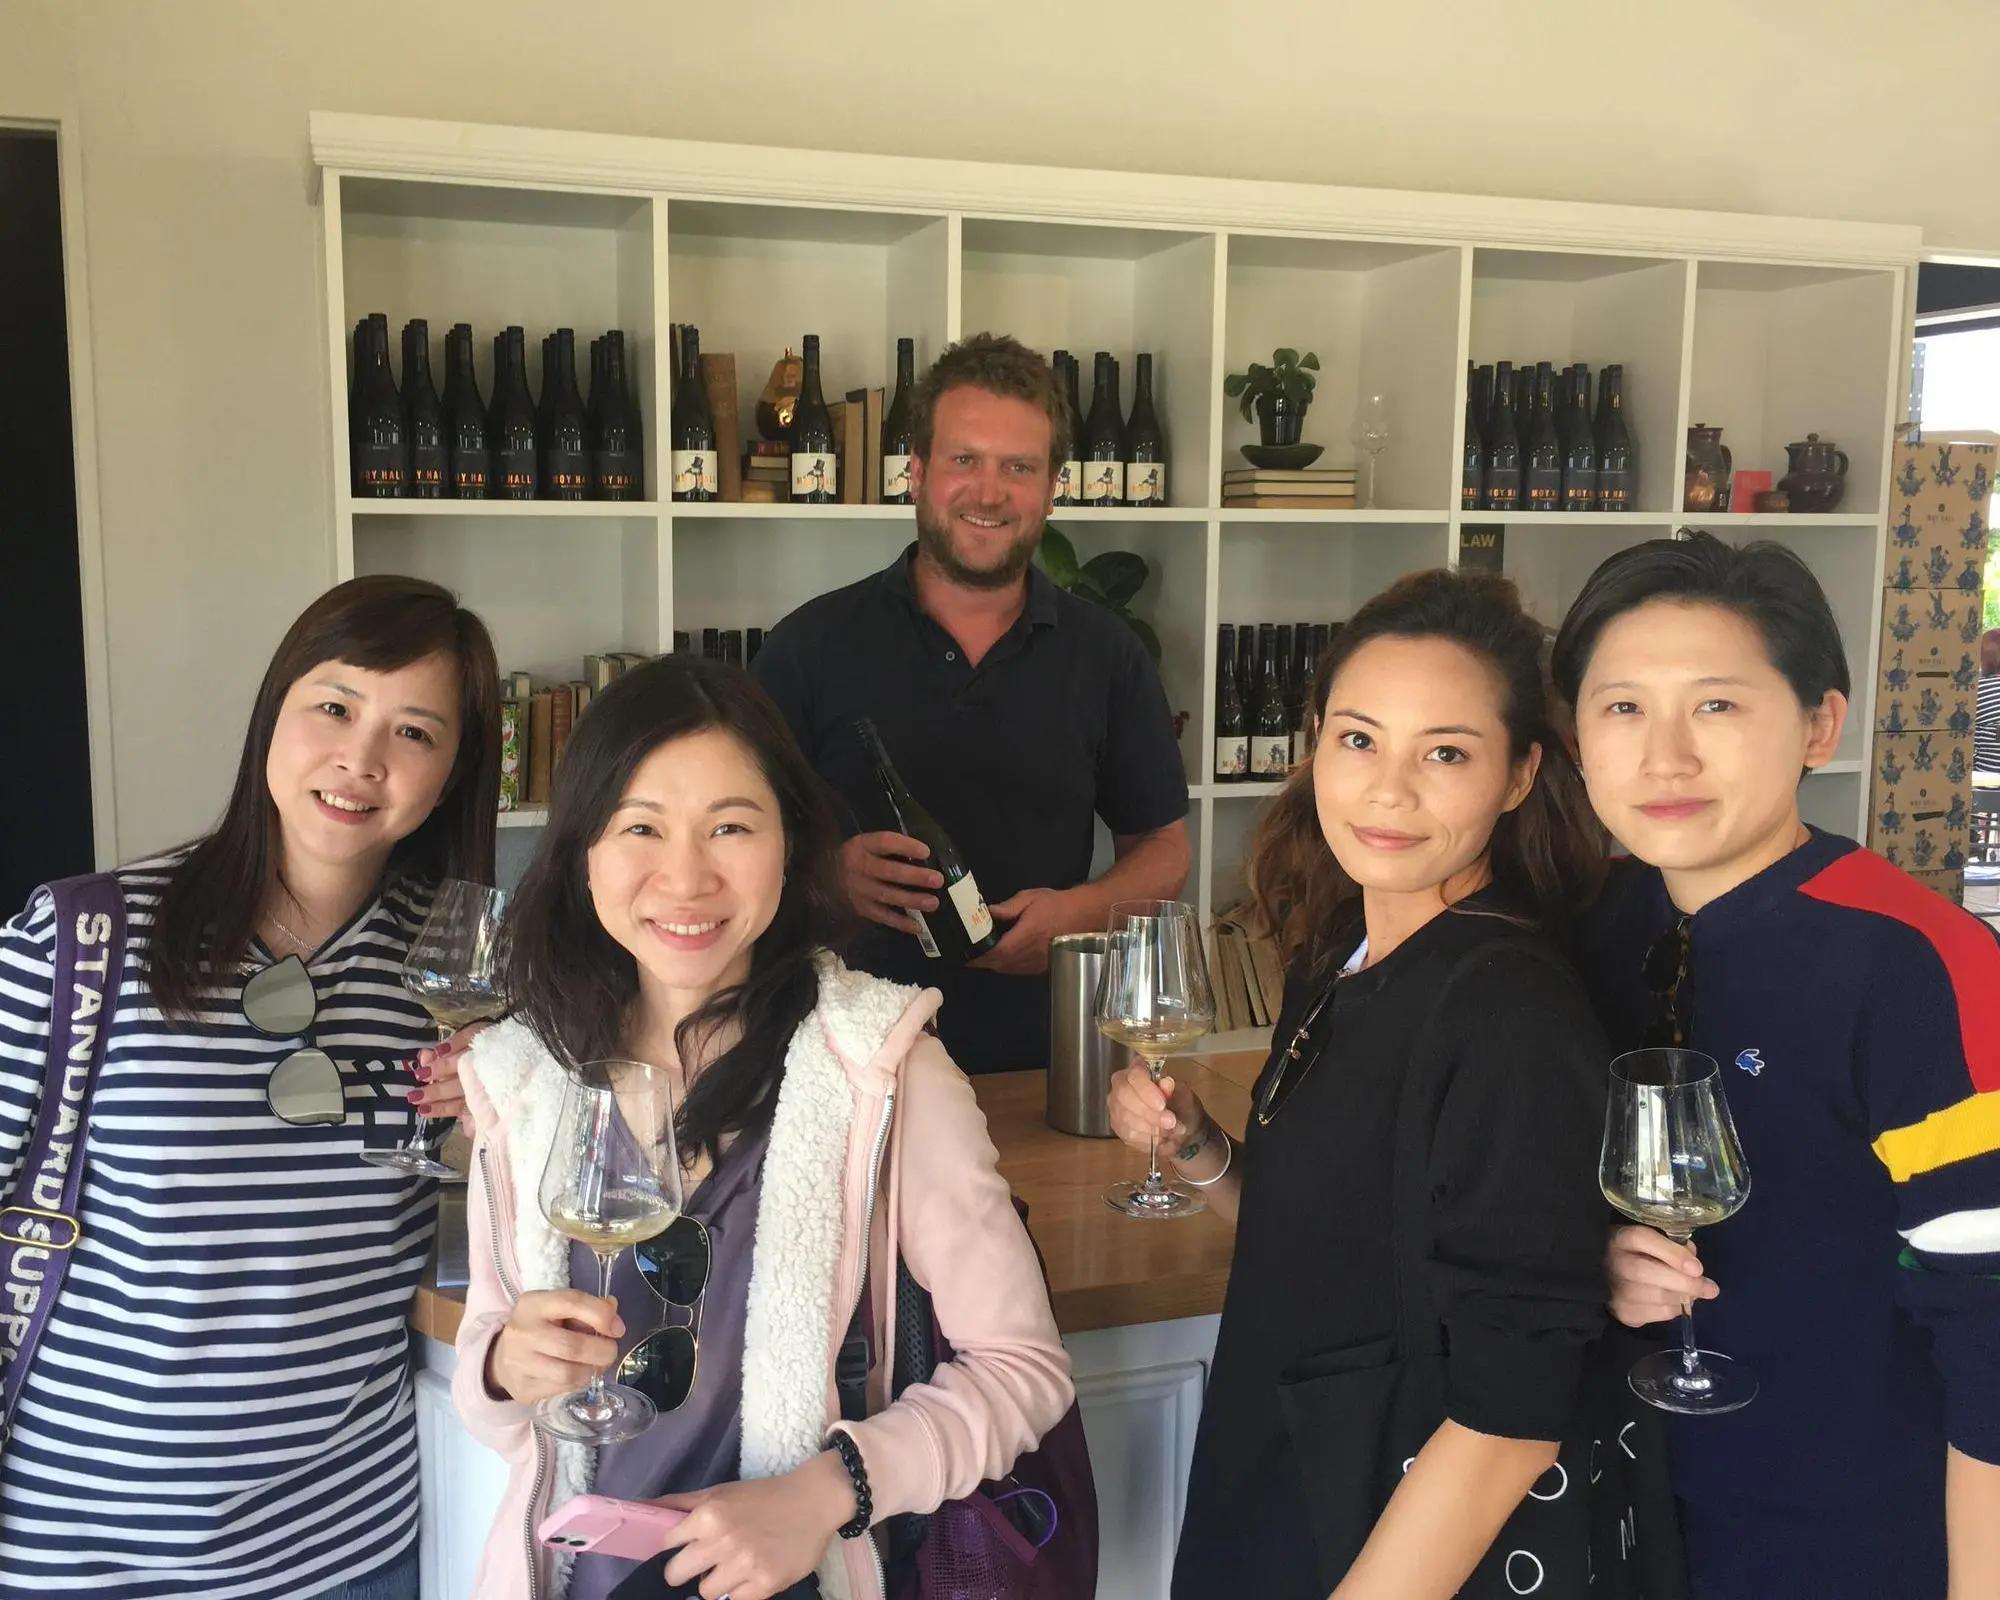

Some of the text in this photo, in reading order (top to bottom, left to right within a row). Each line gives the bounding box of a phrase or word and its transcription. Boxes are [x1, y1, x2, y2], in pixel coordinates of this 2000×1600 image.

[1461, 533, 1496, 548] LAW
[0, 911, 113, 1364] STANDARD SUPP
